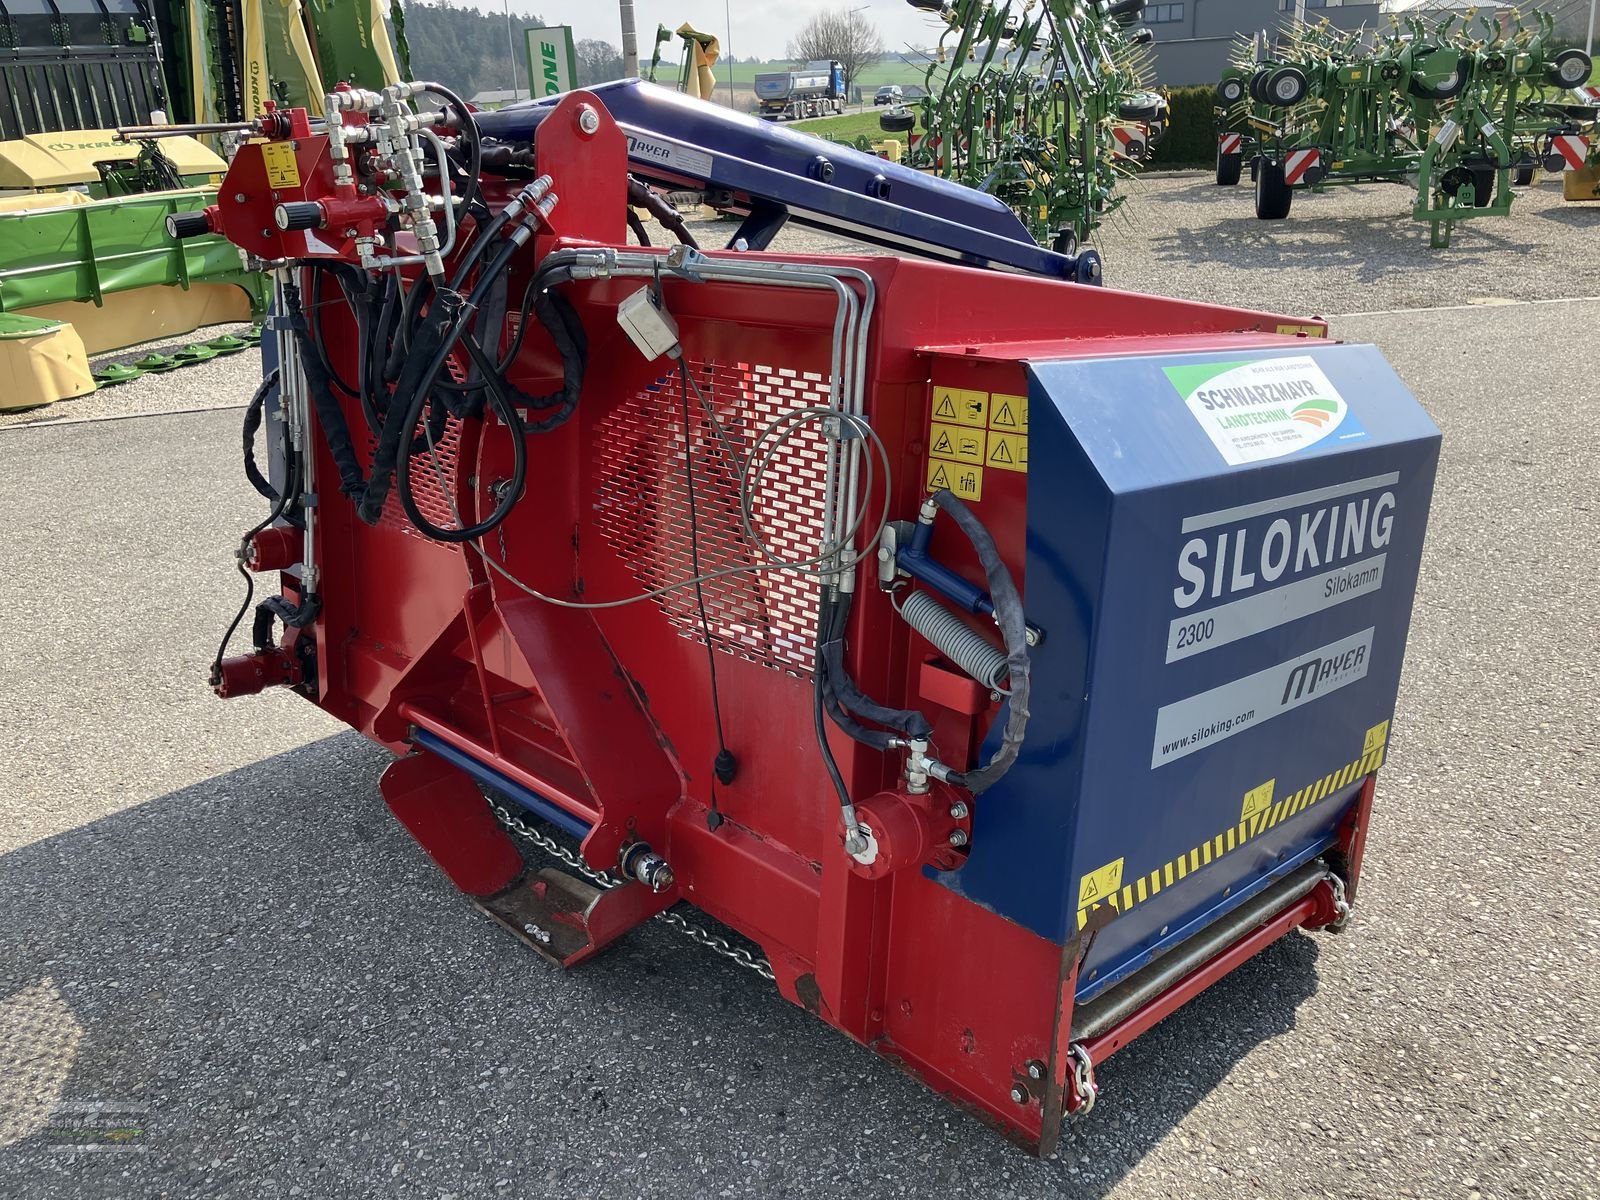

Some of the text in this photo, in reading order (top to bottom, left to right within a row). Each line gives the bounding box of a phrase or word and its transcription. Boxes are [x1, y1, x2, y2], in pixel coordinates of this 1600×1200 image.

[540, 41, 560, 97] ONE
[1197, 379, 1319, 411] SCHWARZMAYR
[1216, 408, 1292, 430] LANDTECHNIK
[1173, 491, 1396, 609] SILOKING
[1324, 566, 1379, 598] Silokamm
[1176, 618, 1215, 650] 2300
[1280, 644, 1367, 706] MAYER
[1161, 709, 1256, 755] www.siloking.com
